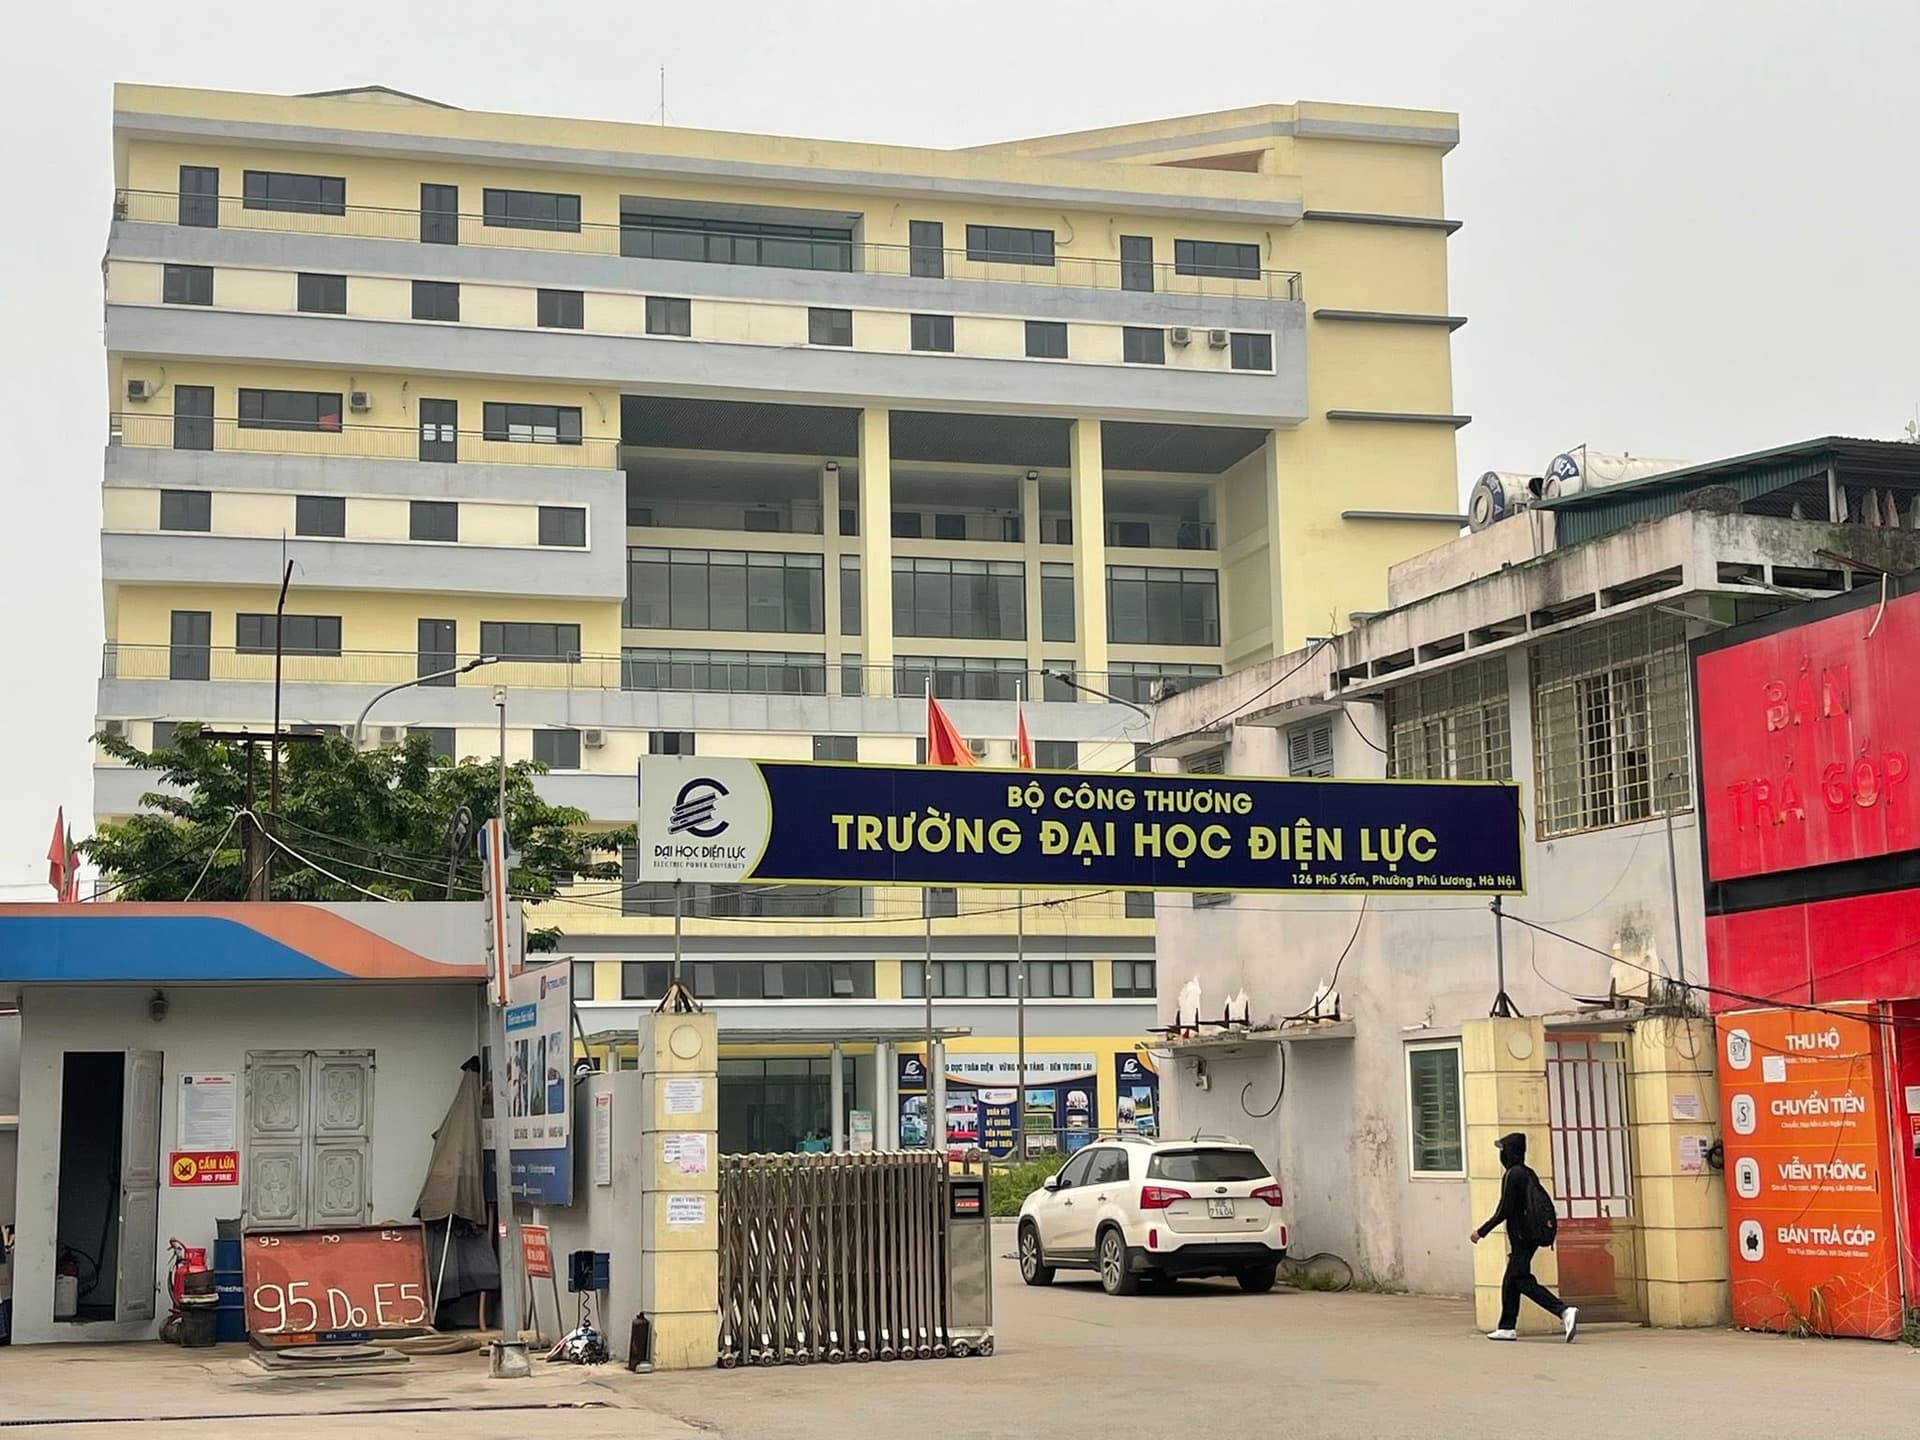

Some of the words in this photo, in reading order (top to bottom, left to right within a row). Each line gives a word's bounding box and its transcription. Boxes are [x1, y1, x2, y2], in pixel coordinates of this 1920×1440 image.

[1763, 654, 1852, 732] BÁN
[1727, 753, 1806, 832] TRẢ
[1822, 737, 1909, 815] GÓP
[1007, 780, 1045, 814] BỘ
[1053, 781, 1136, 811] CÔNG
[1144, 788, 1252, 815] THƯƠNG
[831, 805, 1022, 855] TRƯỜNG
[1039, 820, 1115, 866] ĐẠI
[1133, 822, 1232, 869] HỌC
[1247, 817, 1343, 871] ĐIỆN
[1360, 823, 1438, 872] LỰC
[653, 860, 683, 868] ELECTRIC
[654, 845, 673, 859] ĐẠI
[675, 845, 700, 860] HỌC
[727, 846, 747, 861] LỰC
[1292, 874, 1313, 885] 126
[1315, 872, 1337, 885] Phố
[1339, 873, 1369, 887] Xốm,
[1372, 874, 1414, 888] Phường
[1416, 874, 1438, 886] Phú
[1440, 875, 1476, 888] Lương,
[1479, 875, 1495, 886] Hà
[1497, 875, 1516, 887] Nội
[1784, 1033, 1816, 1051] THU
[1817, 1027, 1840, 1051] HỘ
[1771, 1089, 1829, 1115] CHUYỂN
[1830, 1089, 1866, 1113] TIỀN
[198, 1155, 217, 1169] CẤM
[219, 1154, 235, 1169] LỬA
[1778, 1156, 1812, 1180] VIỄN
[1813, 1159, 1867, 1180] THÔNG
[201, 1173, 213, 1182] NO
[214, 1173, 232, 1182] FIRE
[1777, 1223, 1809, 1244] BÁN
[1810, 1223, 1842, 1245] TRẢ
[1843, 1223, 1876, 1247] GÓP
[253, 1281, 318, 1333] 95
[326, 1288, 368, 1329] Do
[373, 1283, 426, 1326] E5
